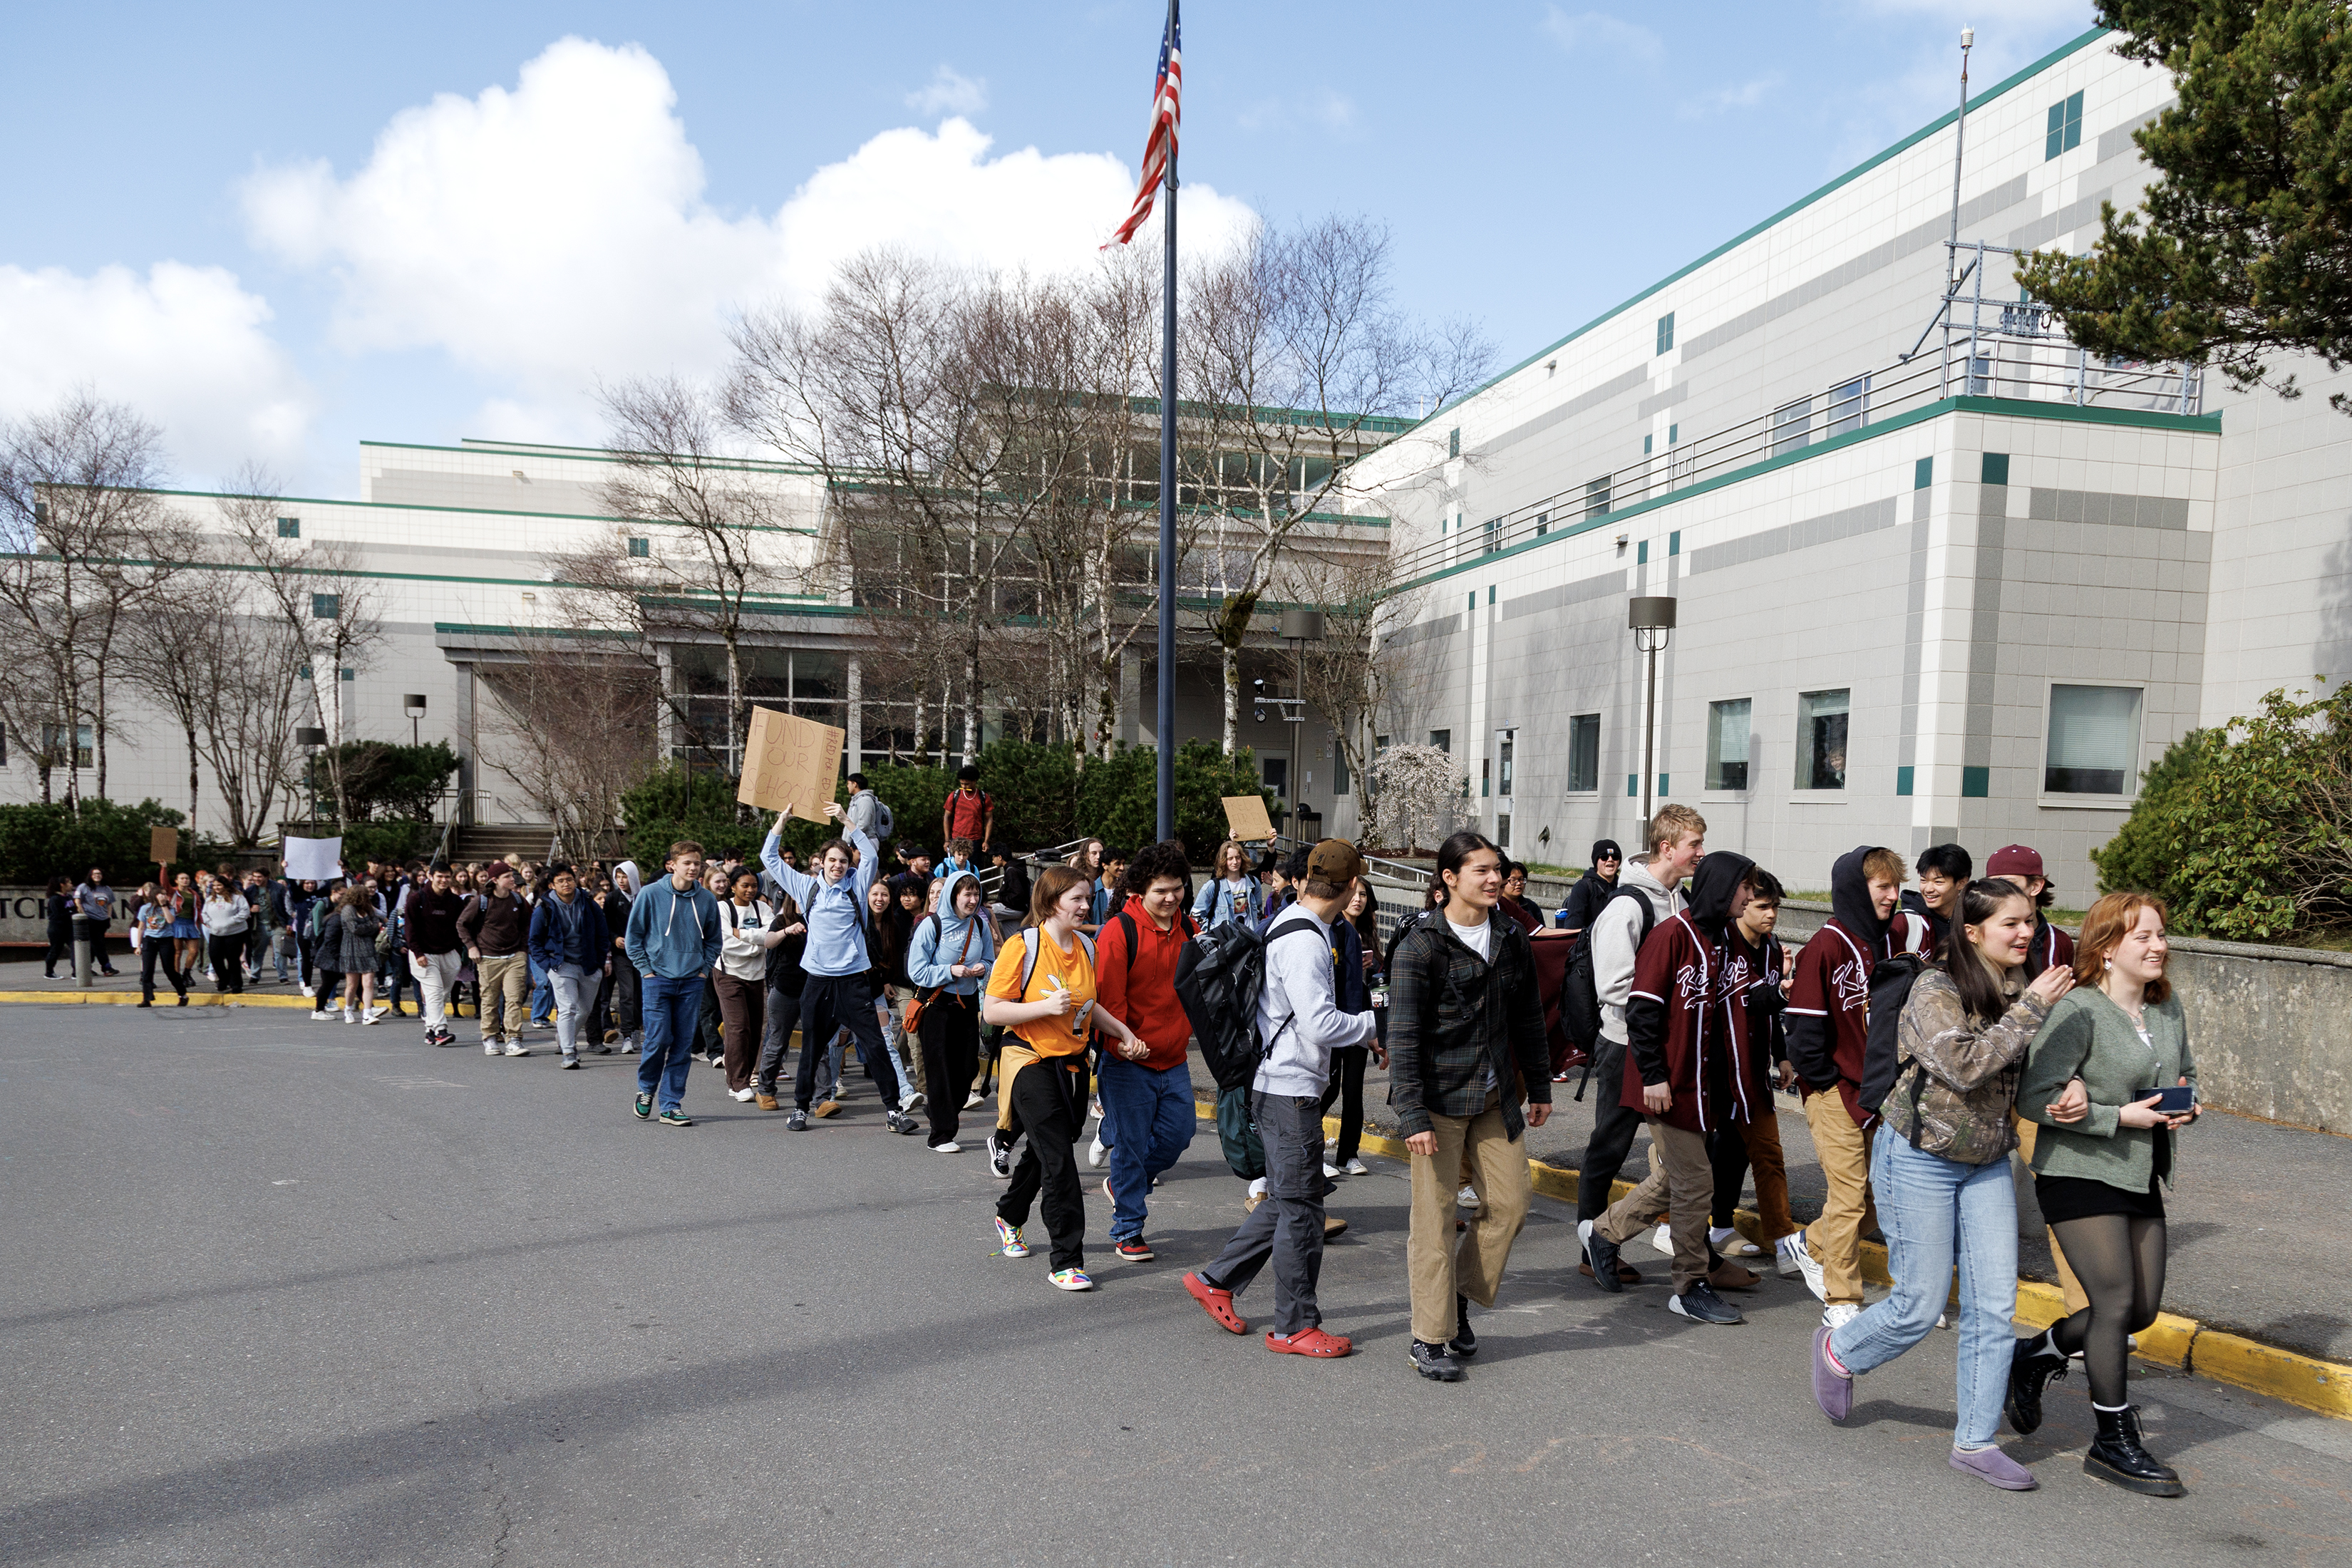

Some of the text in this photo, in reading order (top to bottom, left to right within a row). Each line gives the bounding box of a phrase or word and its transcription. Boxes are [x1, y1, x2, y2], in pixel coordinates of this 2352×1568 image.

[754, 711, 815, 748] FUND
[767, 747, 810, 773] OUR
[822, 729, 840, 790] #RED FOR ED
[744, 767, 816, 810] SCHOOLS
